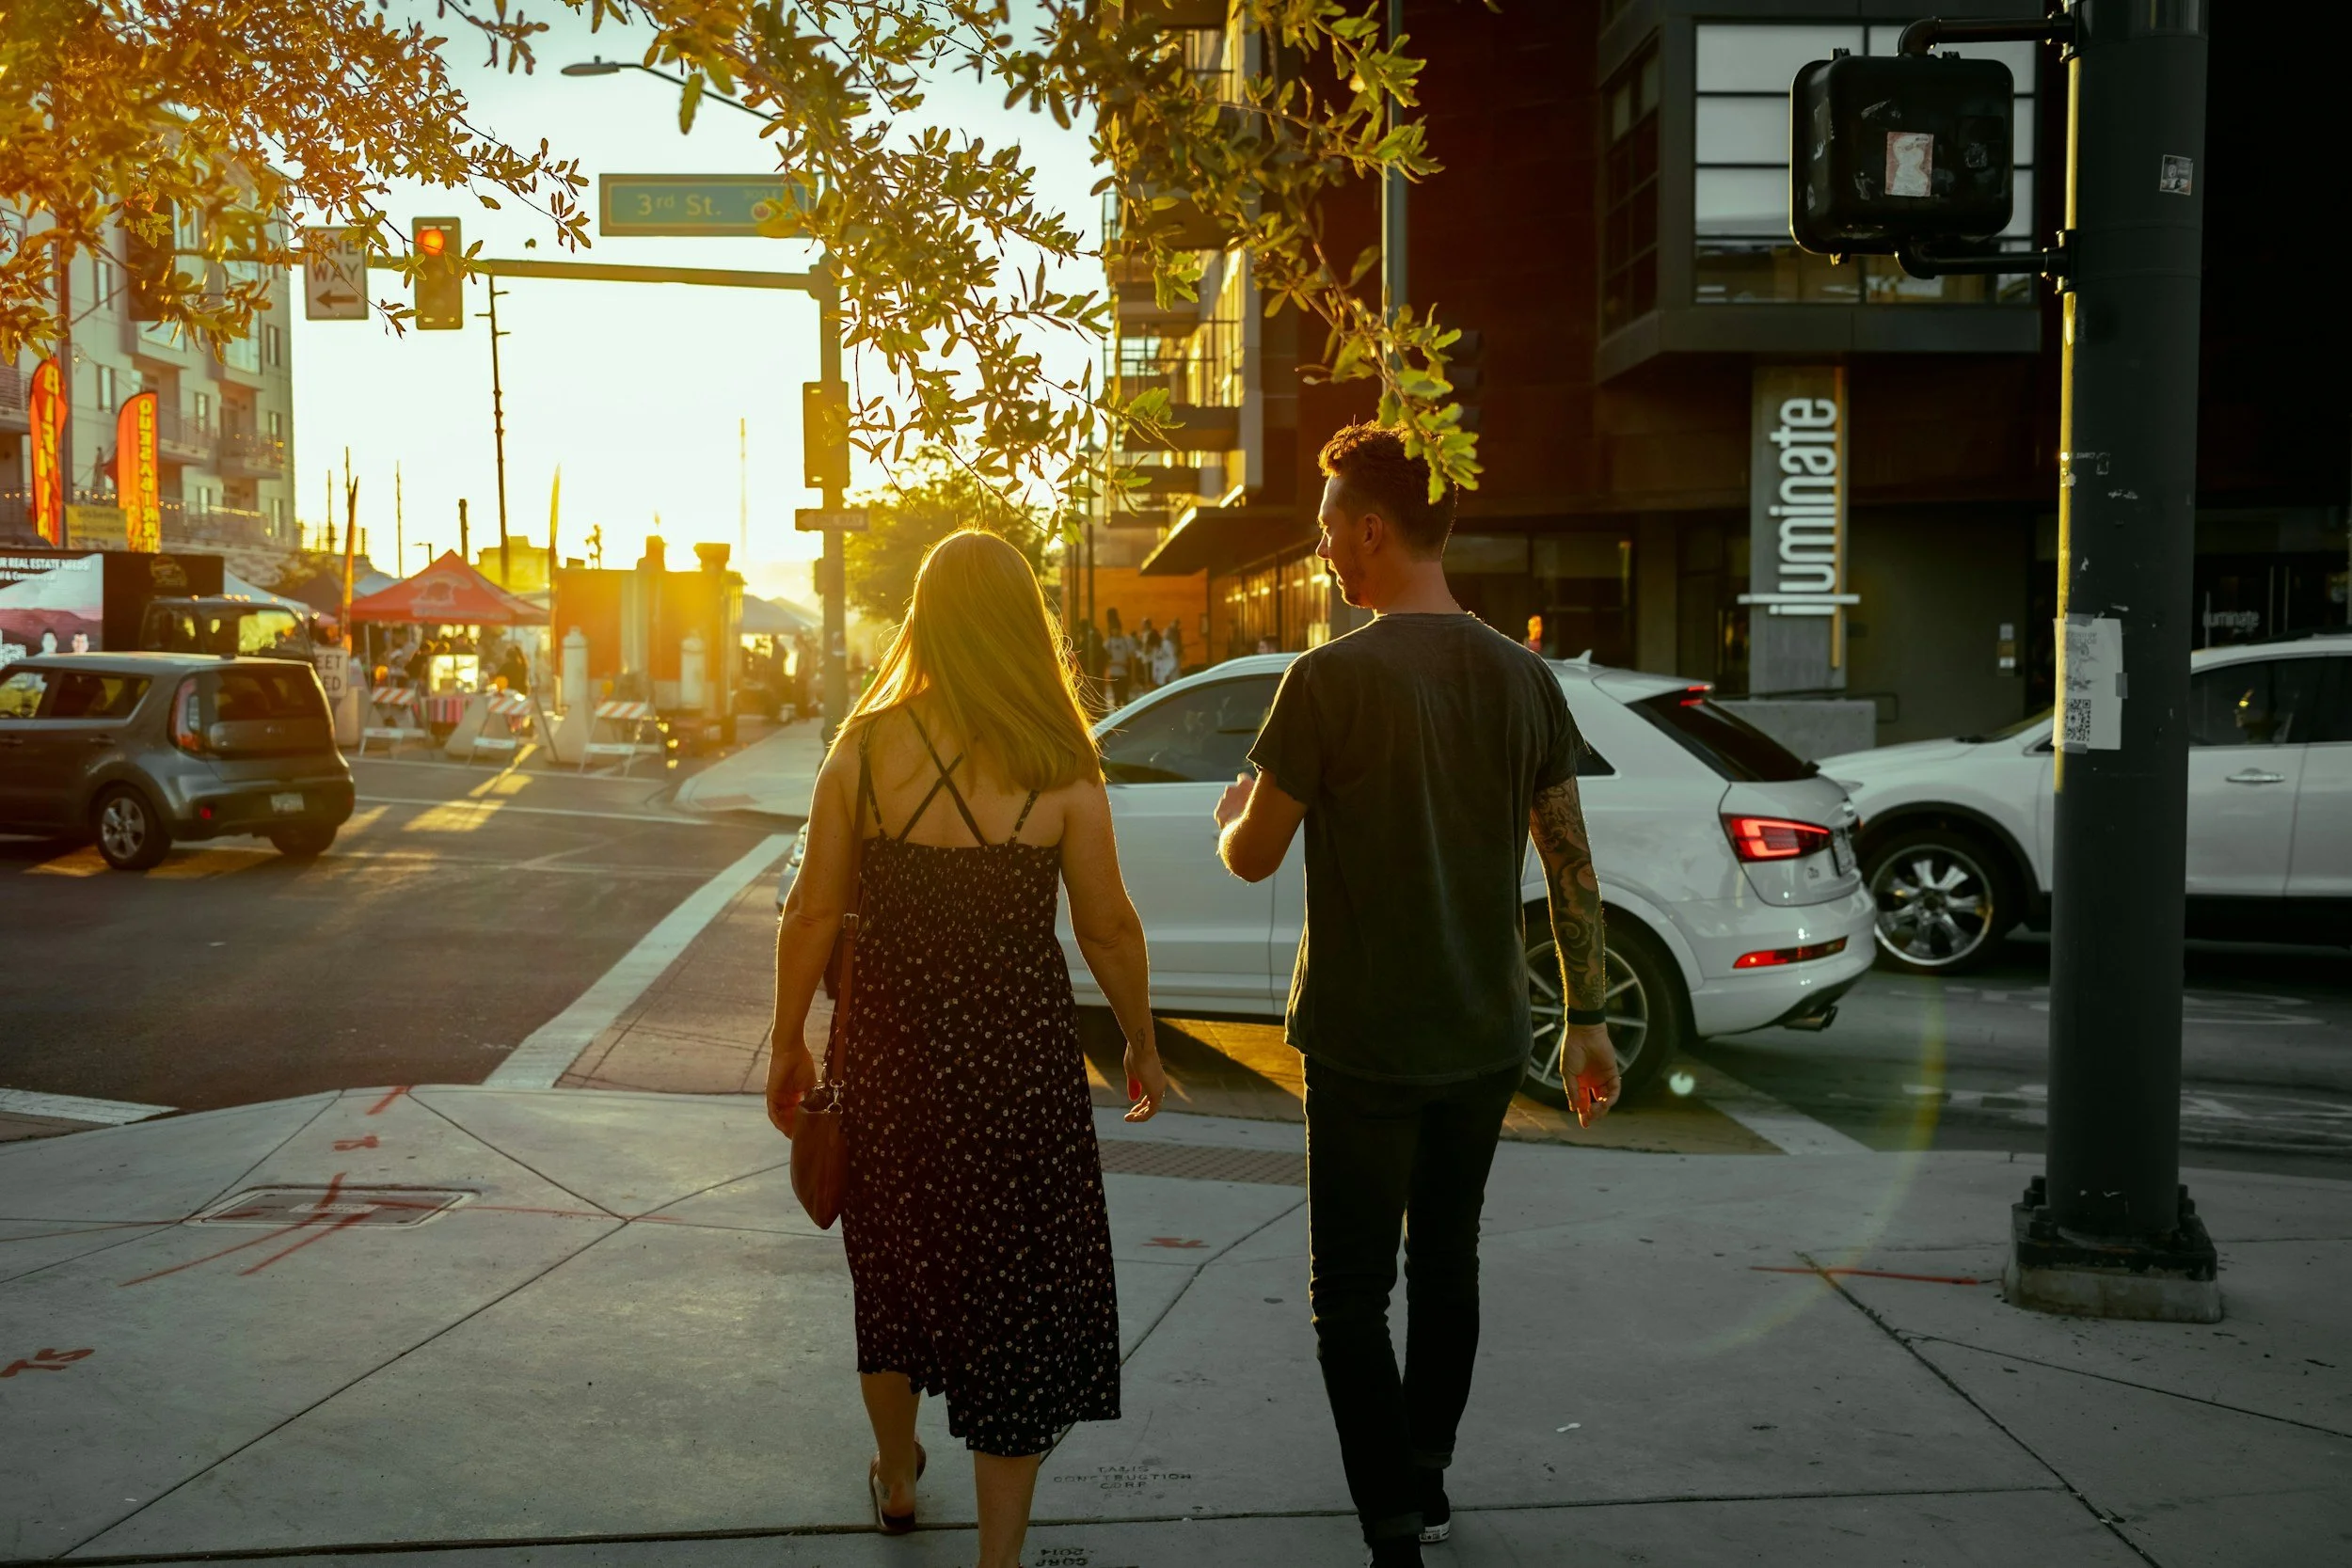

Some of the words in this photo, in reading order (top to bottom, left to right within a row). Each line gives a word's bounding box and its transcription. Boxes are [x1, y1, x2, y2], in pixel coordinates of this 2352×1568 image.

[637, 193, 675, 216] 3rd
[686, 194, 722, 216] St.
[312, 263, 359, 283] WAY
